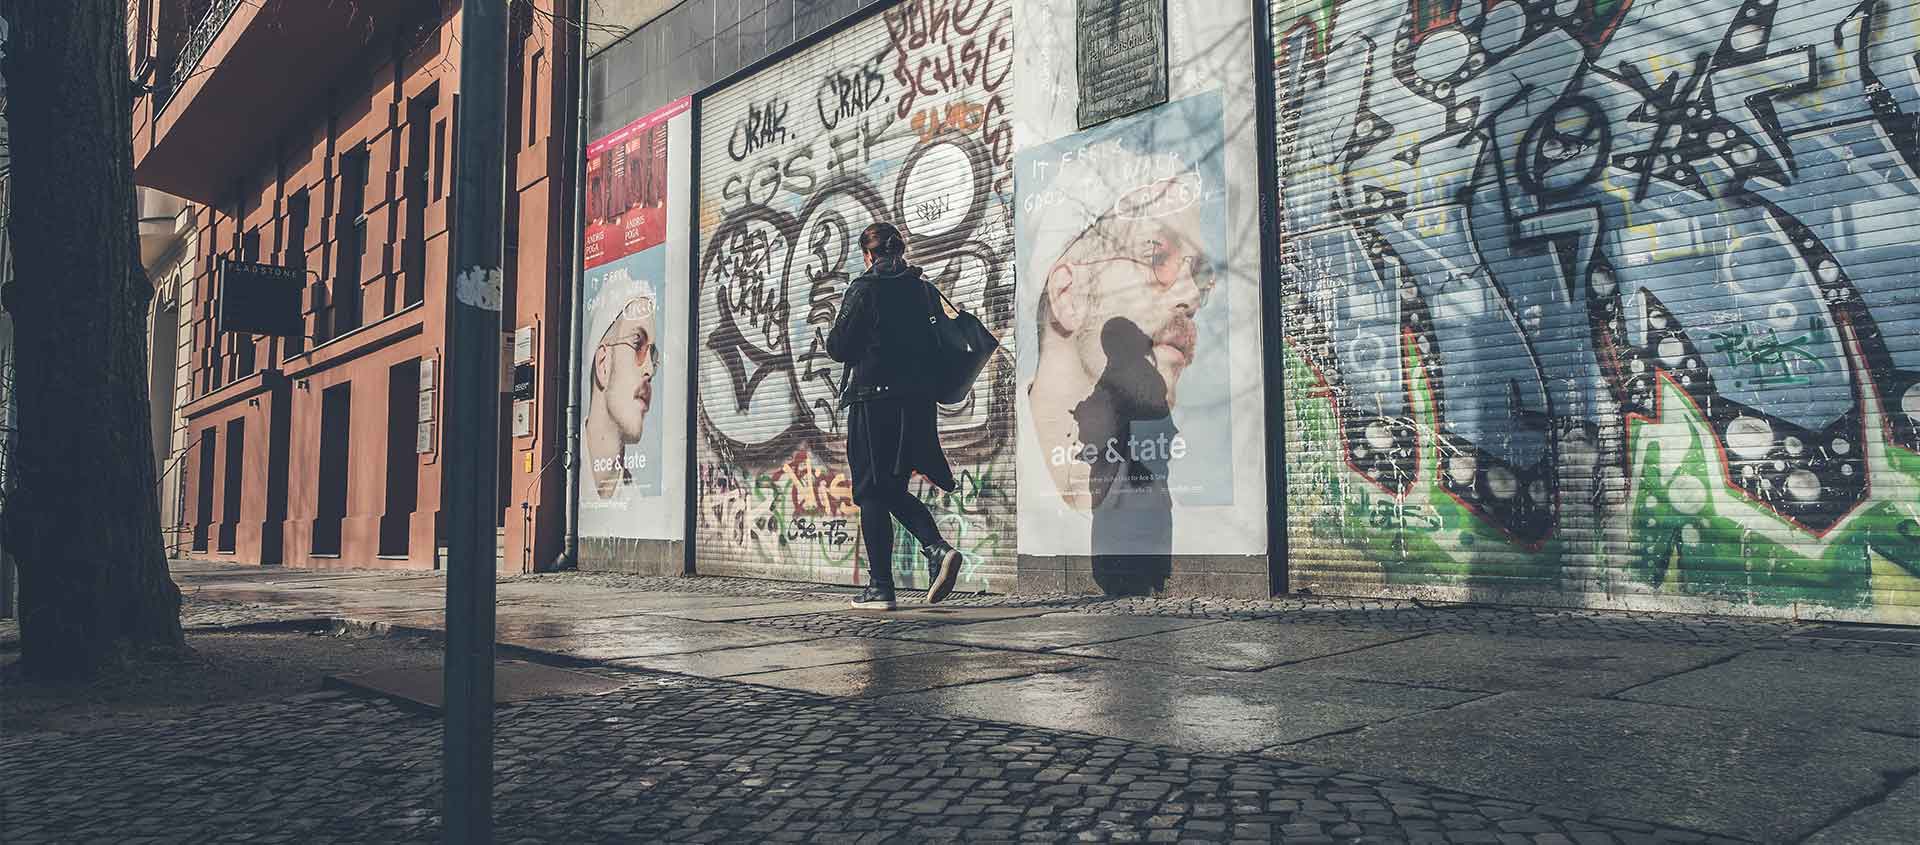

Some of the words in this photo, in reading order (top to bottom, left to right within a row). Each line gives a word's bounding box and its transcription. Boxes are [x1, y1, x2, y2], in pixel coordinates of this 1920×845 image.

[1031, 159, 1049, 182] IT
[625, 215, 646, 230] ANDRIS
[624, 227, 640, 242] POGA
[1051, 442, 1100, 465] ace
[1105, 437, 1127, 463] &
[1127, 432, 1187, 462] tate
[593, 457, 614, 472] ace
[614, 454, 623, 471] &
[623, 450, 647, 469] tate
